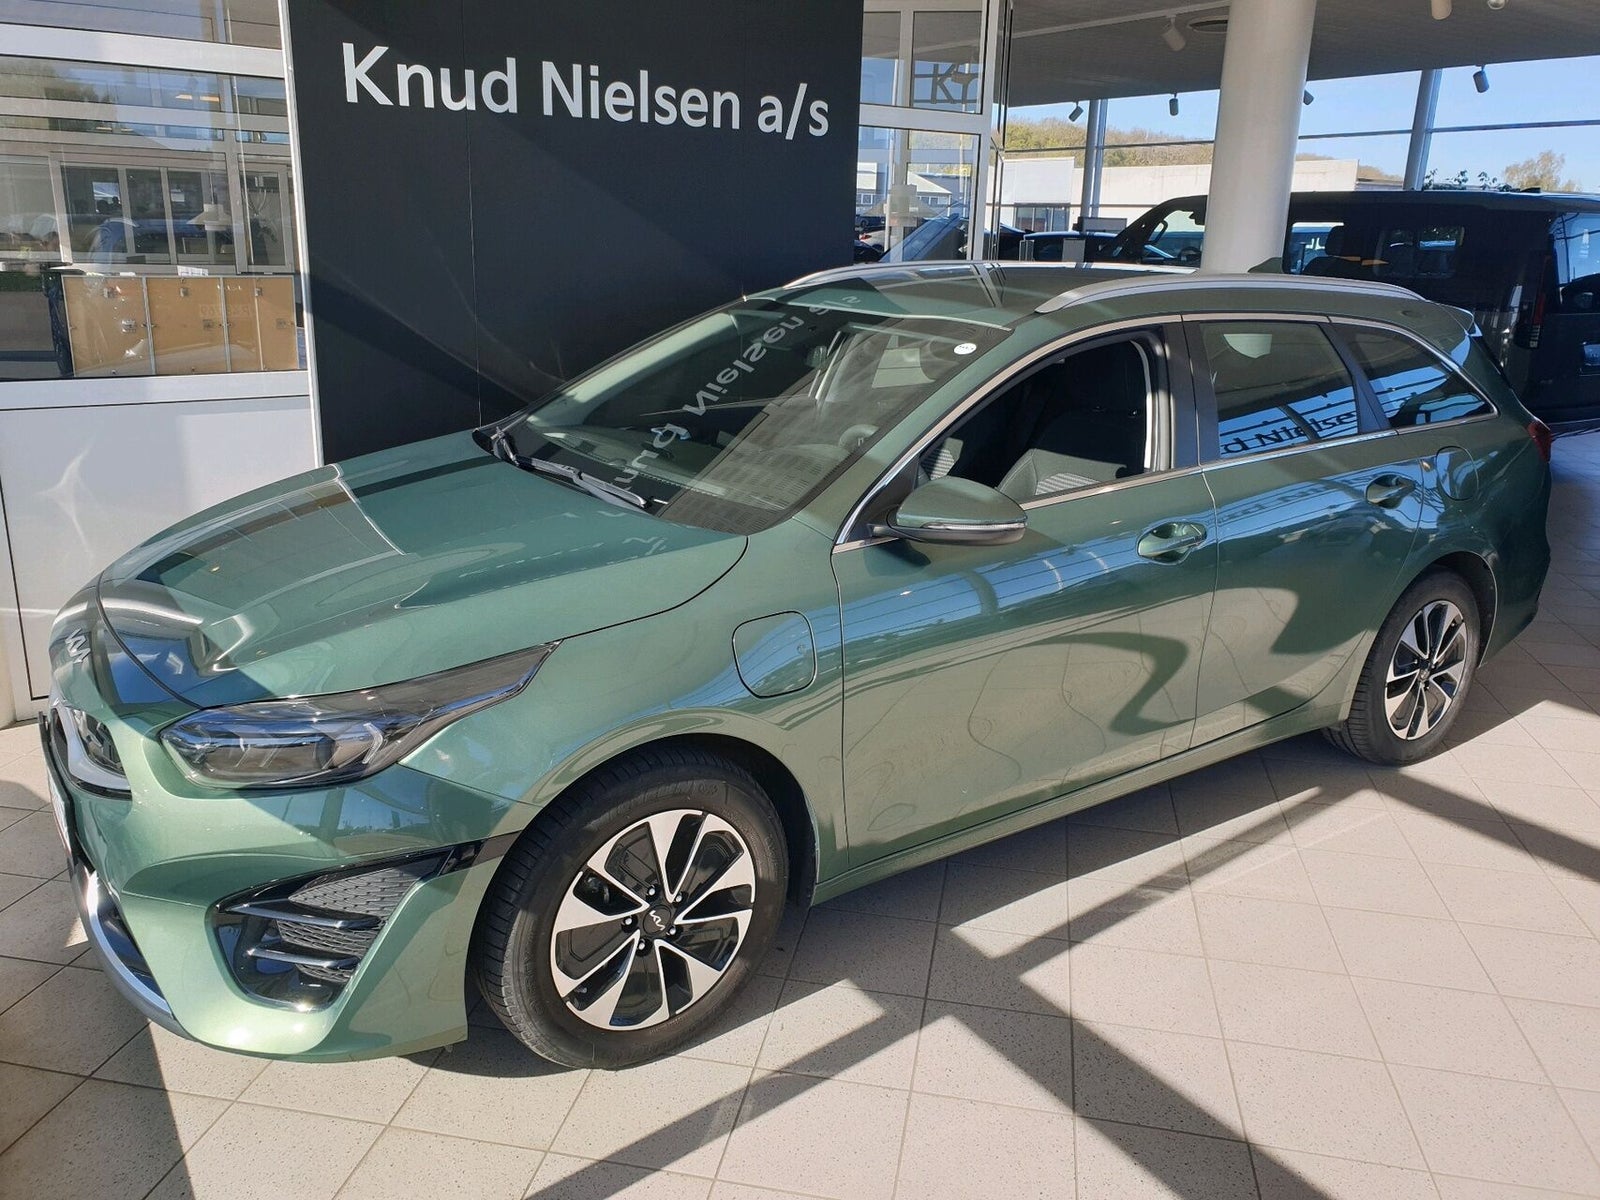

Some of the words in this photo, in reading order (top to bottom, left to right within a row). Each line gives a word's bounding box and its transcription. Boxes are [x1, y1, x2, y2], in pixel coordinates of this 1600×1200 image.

[342, 42, 518, 114] Knud
[542, 60, 740, 130] Nielsen
[757, 82, 829, 140] a/s
